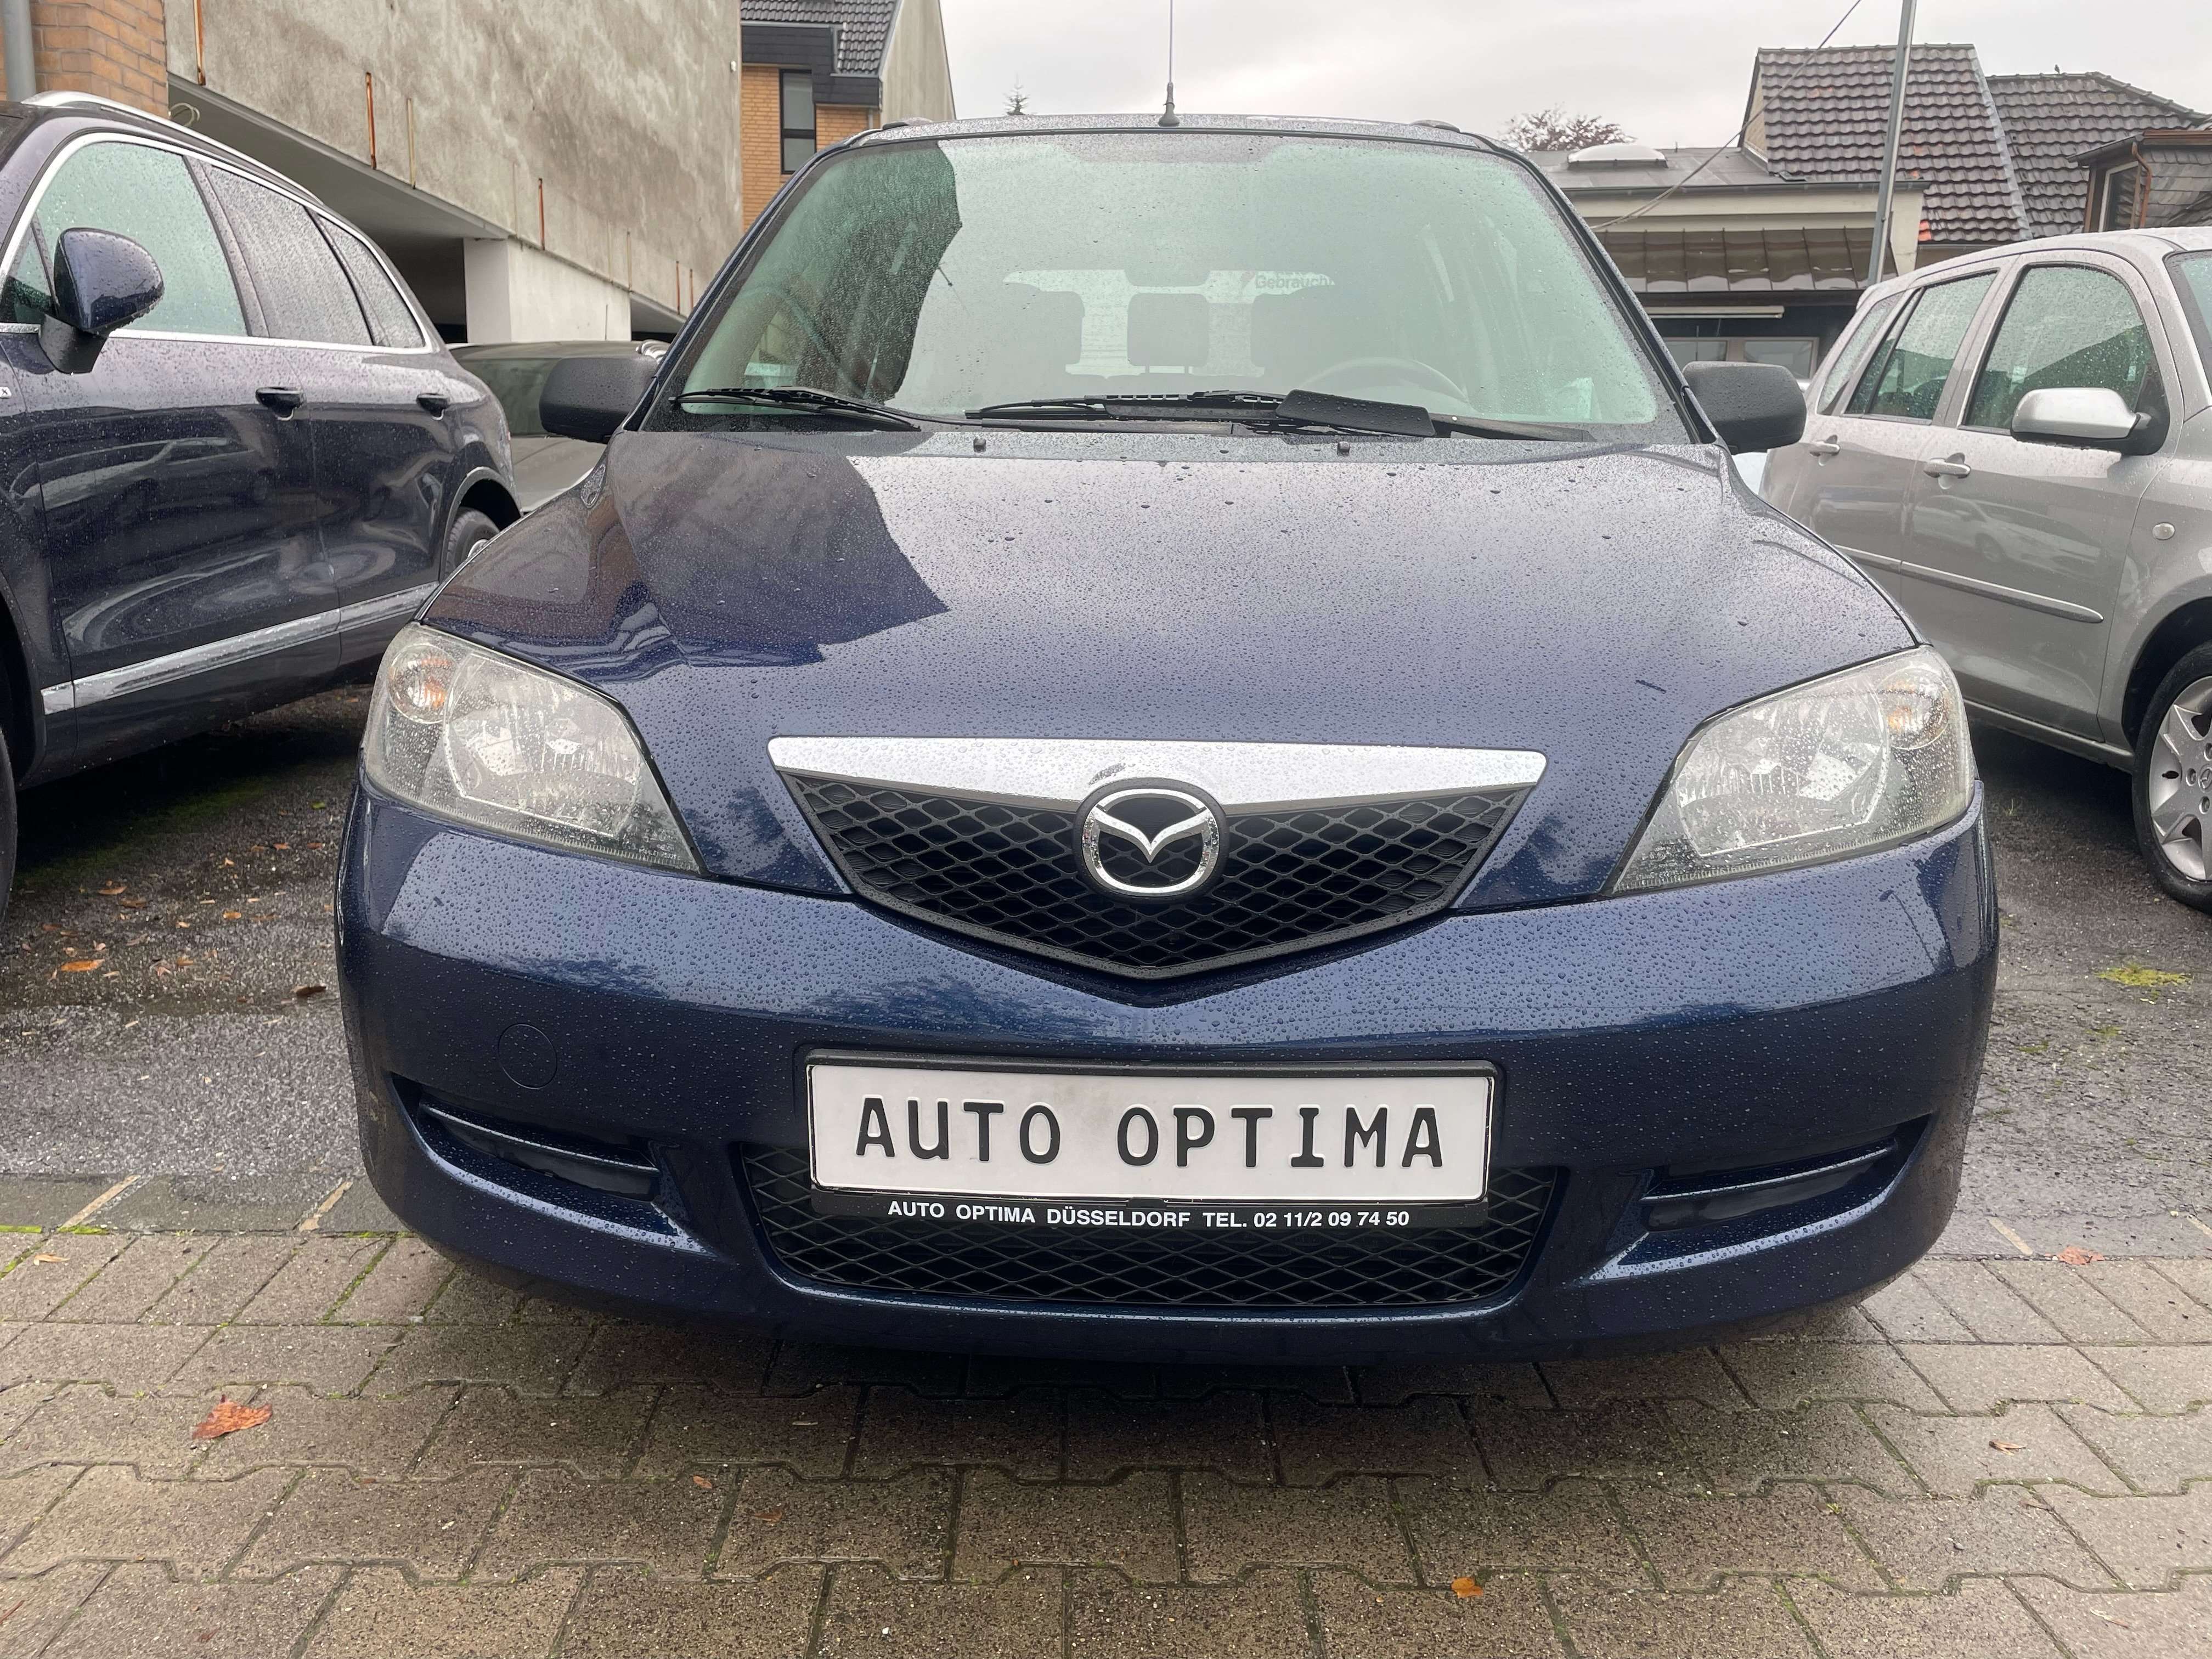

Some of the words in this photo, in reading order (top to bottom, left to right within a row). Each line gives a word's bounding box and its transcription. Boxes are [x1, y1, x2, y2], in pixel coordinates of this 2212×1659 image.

[1255, 274, 1333, 290] Gebrauch
[855, 1097, 1061, 1165] AUTO
[1116, 1107, 1443, 1169] OPTIMA
[888, 1200, 945, 1218] AUTO
[956, 1204, 1036, 1223] OPTIMA
[1047, 1206, 1191, 1227] DÜSSELDORF
[1202, 1212, 1247, 1227] TEL.
[1254, 1212, 1277, 1227] 02
[1283, 1211, 1322, 1227] 11/2
[1328, 1211, 1351, 1227] 09
[1357, 1211, 1380, 1226] 74
[1386, 1211, 1409, 1226] 50
